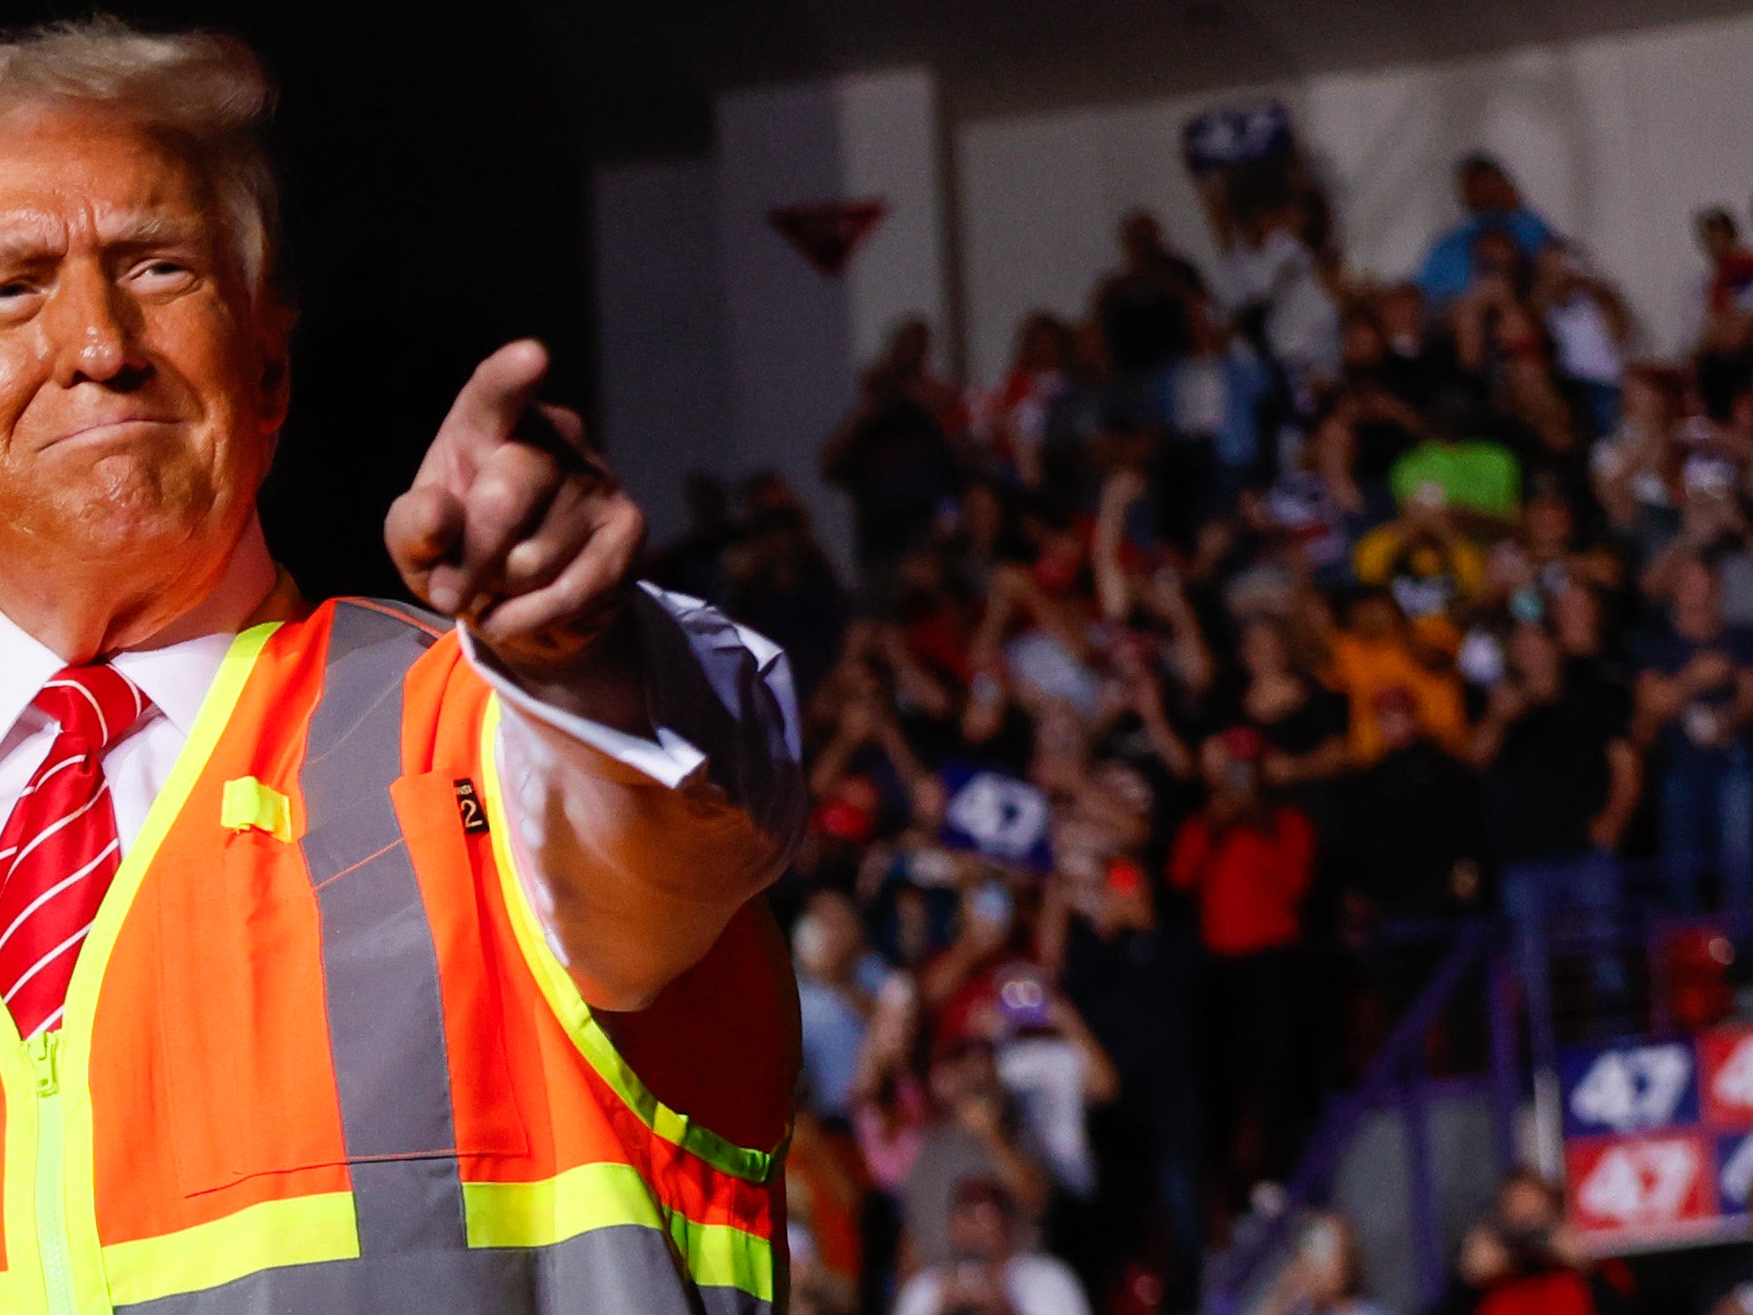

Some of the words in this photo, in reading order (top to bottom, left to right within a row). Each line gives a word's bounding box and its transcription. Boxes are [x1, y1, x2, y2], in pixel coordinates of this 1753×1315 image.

[460, 799, 483, 828] 2
[946, 771, 1049, 855] 47
[1570, 1043, 1691, 1132] 47
[1579, 1139, 1696, 1220] 47
